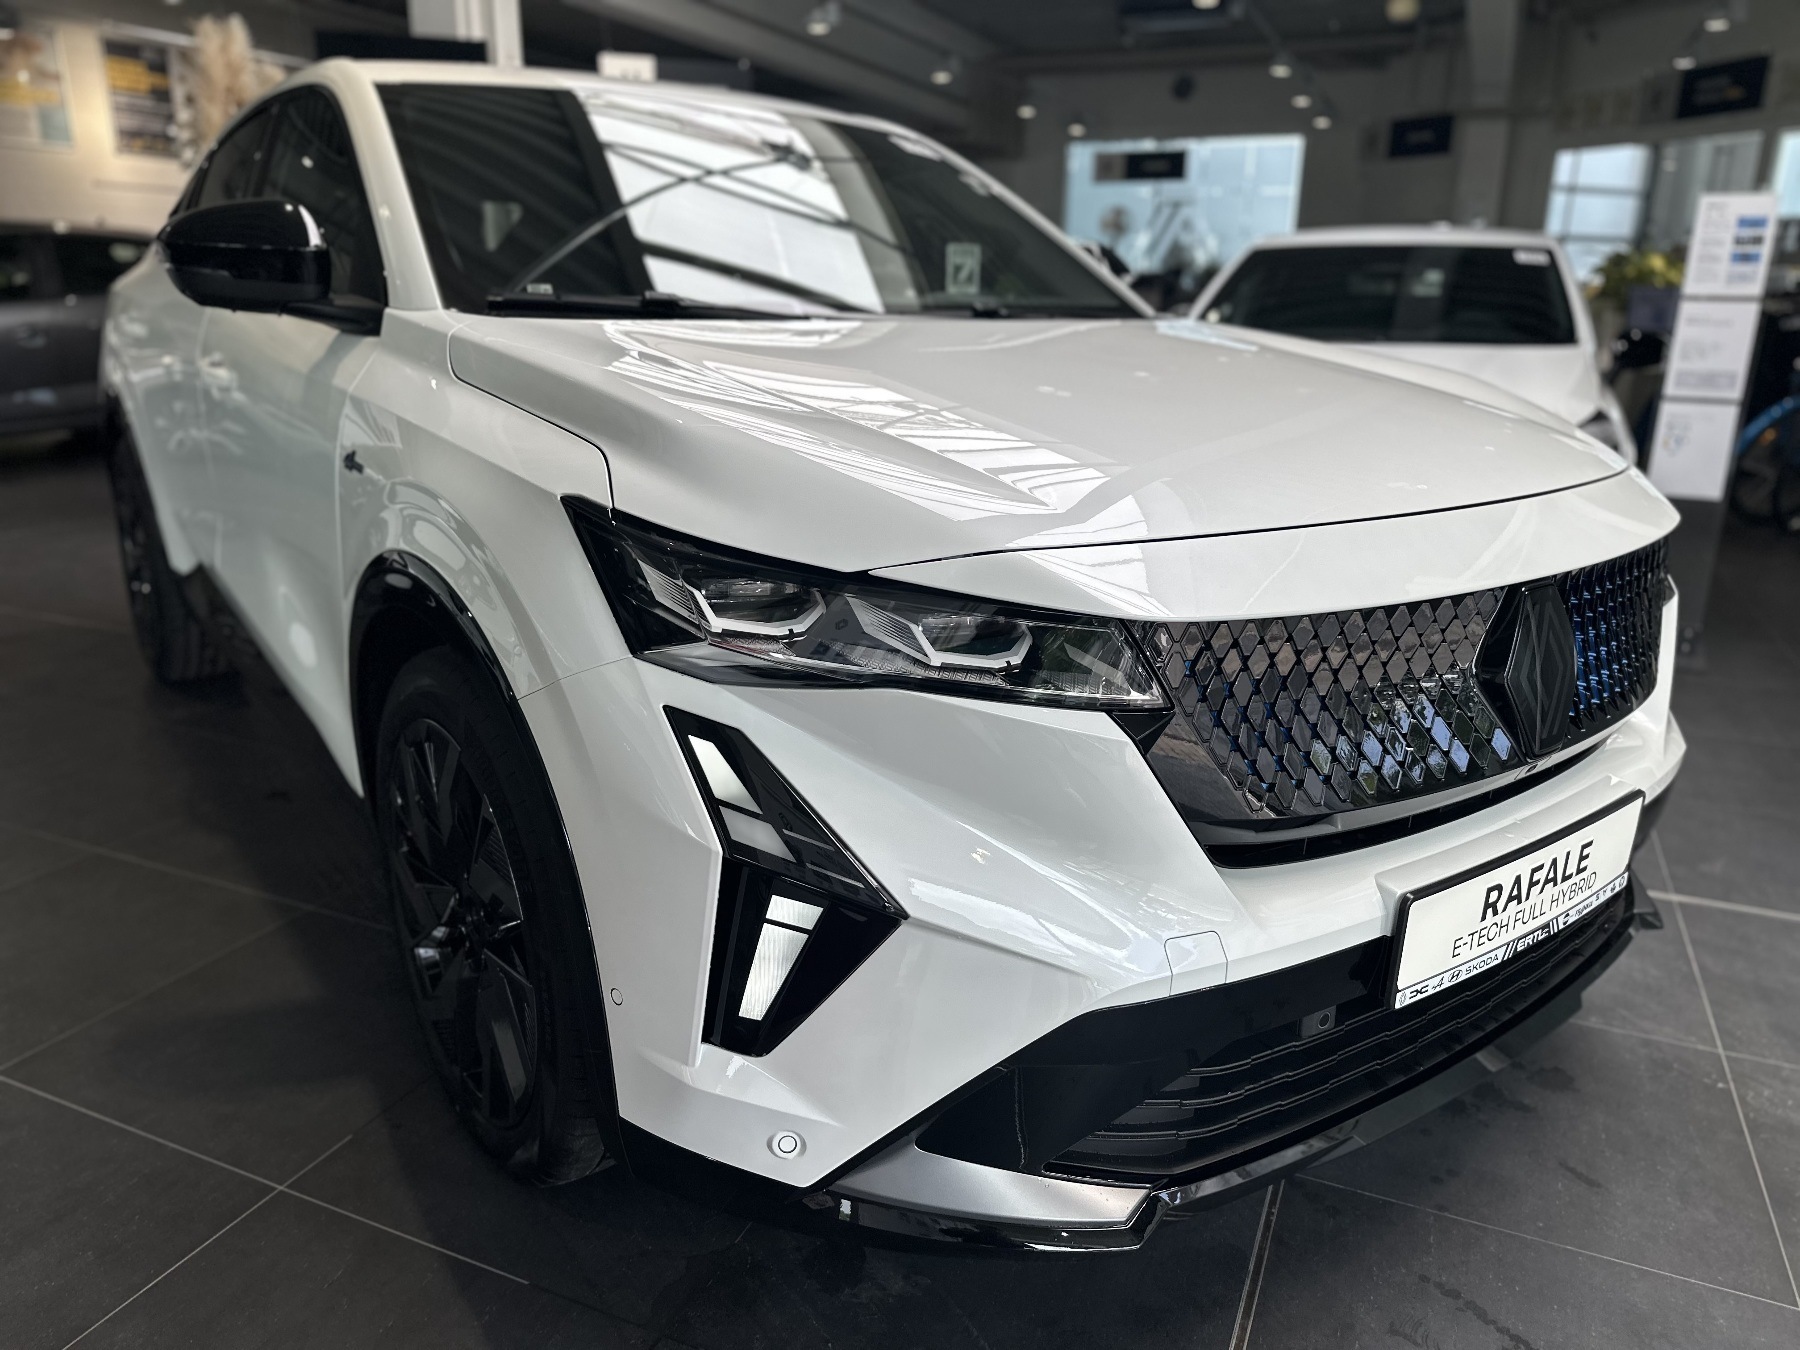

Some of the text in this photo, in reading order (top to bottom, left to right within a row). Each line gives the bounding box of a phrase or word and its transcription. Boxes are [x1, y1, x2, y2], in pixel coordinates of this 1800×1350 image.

[1451, 914, 1511, 959] E-TECH
[1513, 898, 1547, 931] FULL
[1549, 871, 1597, 911] HYBRID
[1479, 839, 1594, 923] RAFALE
